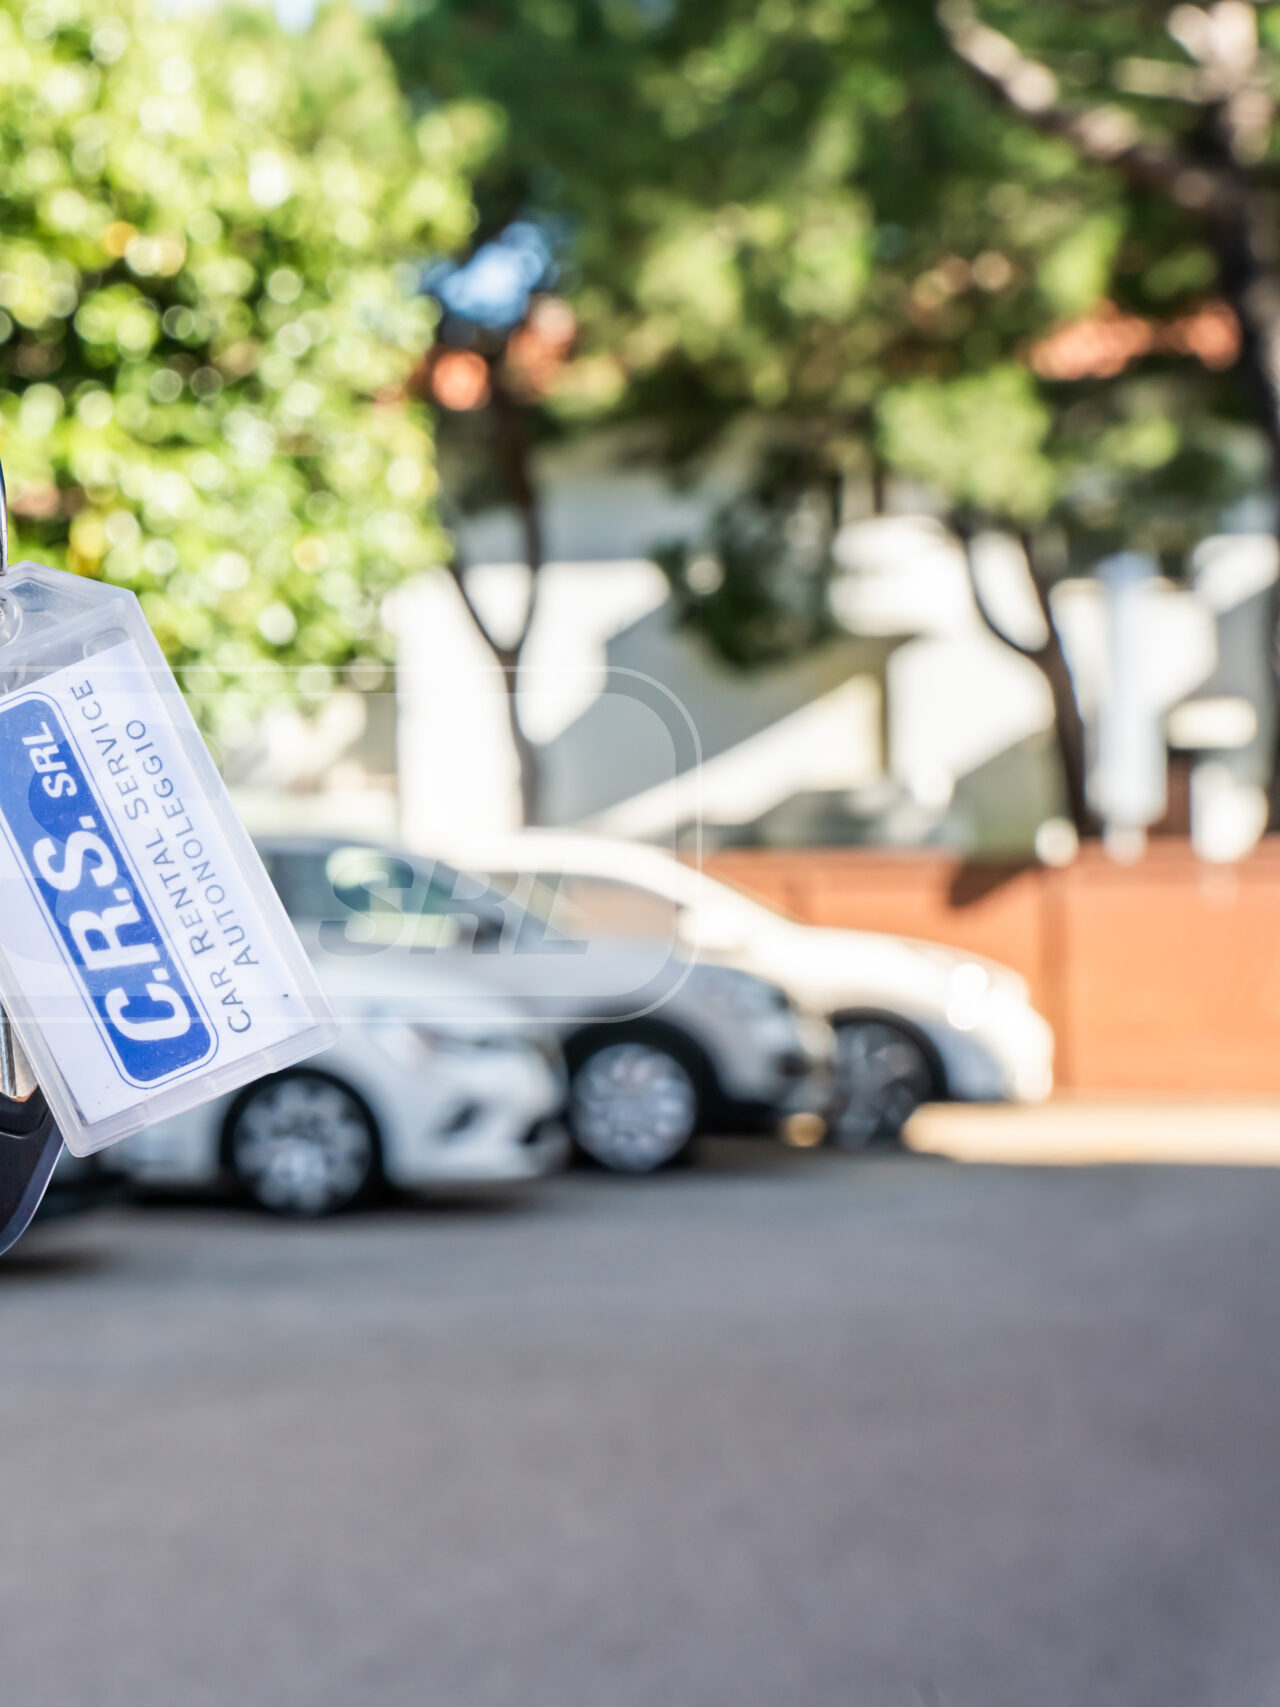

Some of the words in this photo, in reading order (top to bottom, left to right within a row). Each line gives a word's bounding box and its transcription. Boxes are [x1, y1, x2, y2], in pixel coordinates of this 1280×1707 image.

[21, 721, 77, 799] SRL
[71, 679, 150, 821] SERVICE
[125, 719, 260, 966] AUTONOLEGGIO
[145, 827, 215, 956] RENTAL
[33, 815, 191, 1042] C.R.S.
[209, 966, 252, 1033] CAR
